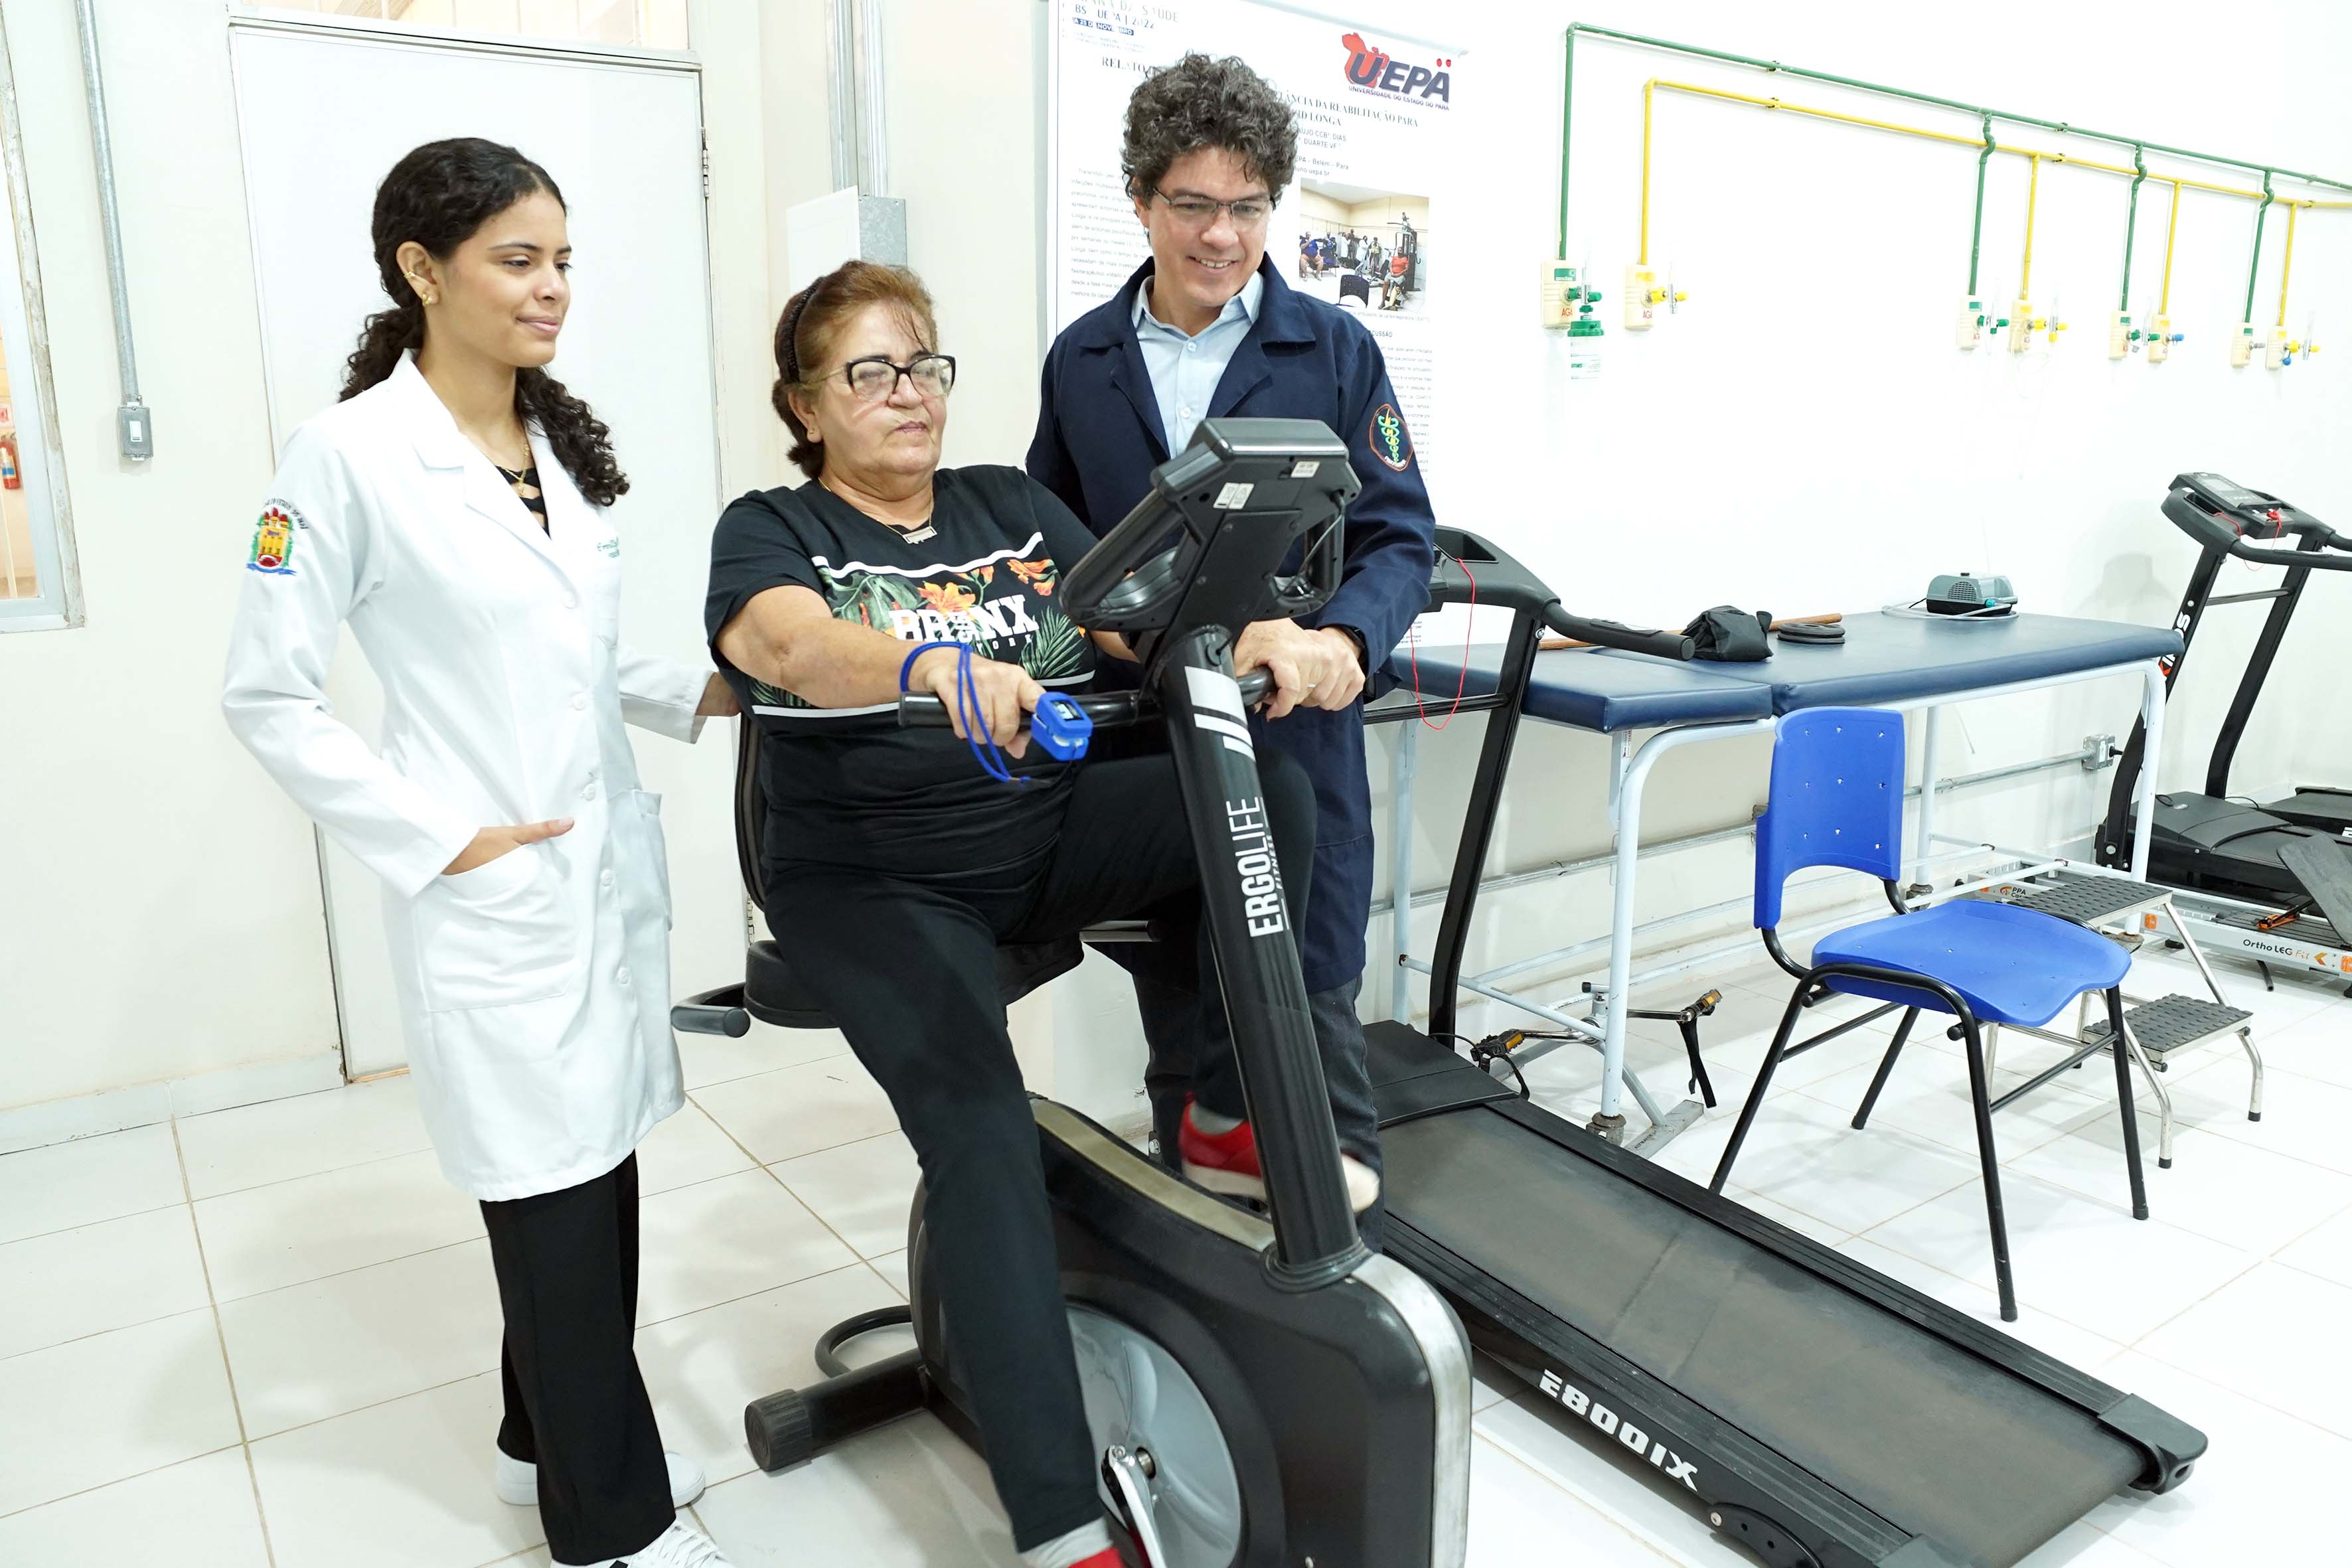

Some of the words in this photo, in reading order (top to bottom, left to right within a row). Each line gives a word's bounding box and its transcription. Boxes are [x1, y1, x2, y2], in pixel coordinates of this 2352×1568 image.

[1348, 86, 1391, 99] UNIVERSIDADE
[1403, 96, 1424, 106] ESTADO
[1304, 137, 1328, 148] DUARTE
[1225, 796, 1284, 937] ERGOLIFE
[2243, 939, 2272, 951] Ortho
[2274, 945, 2293, 956] LEG
